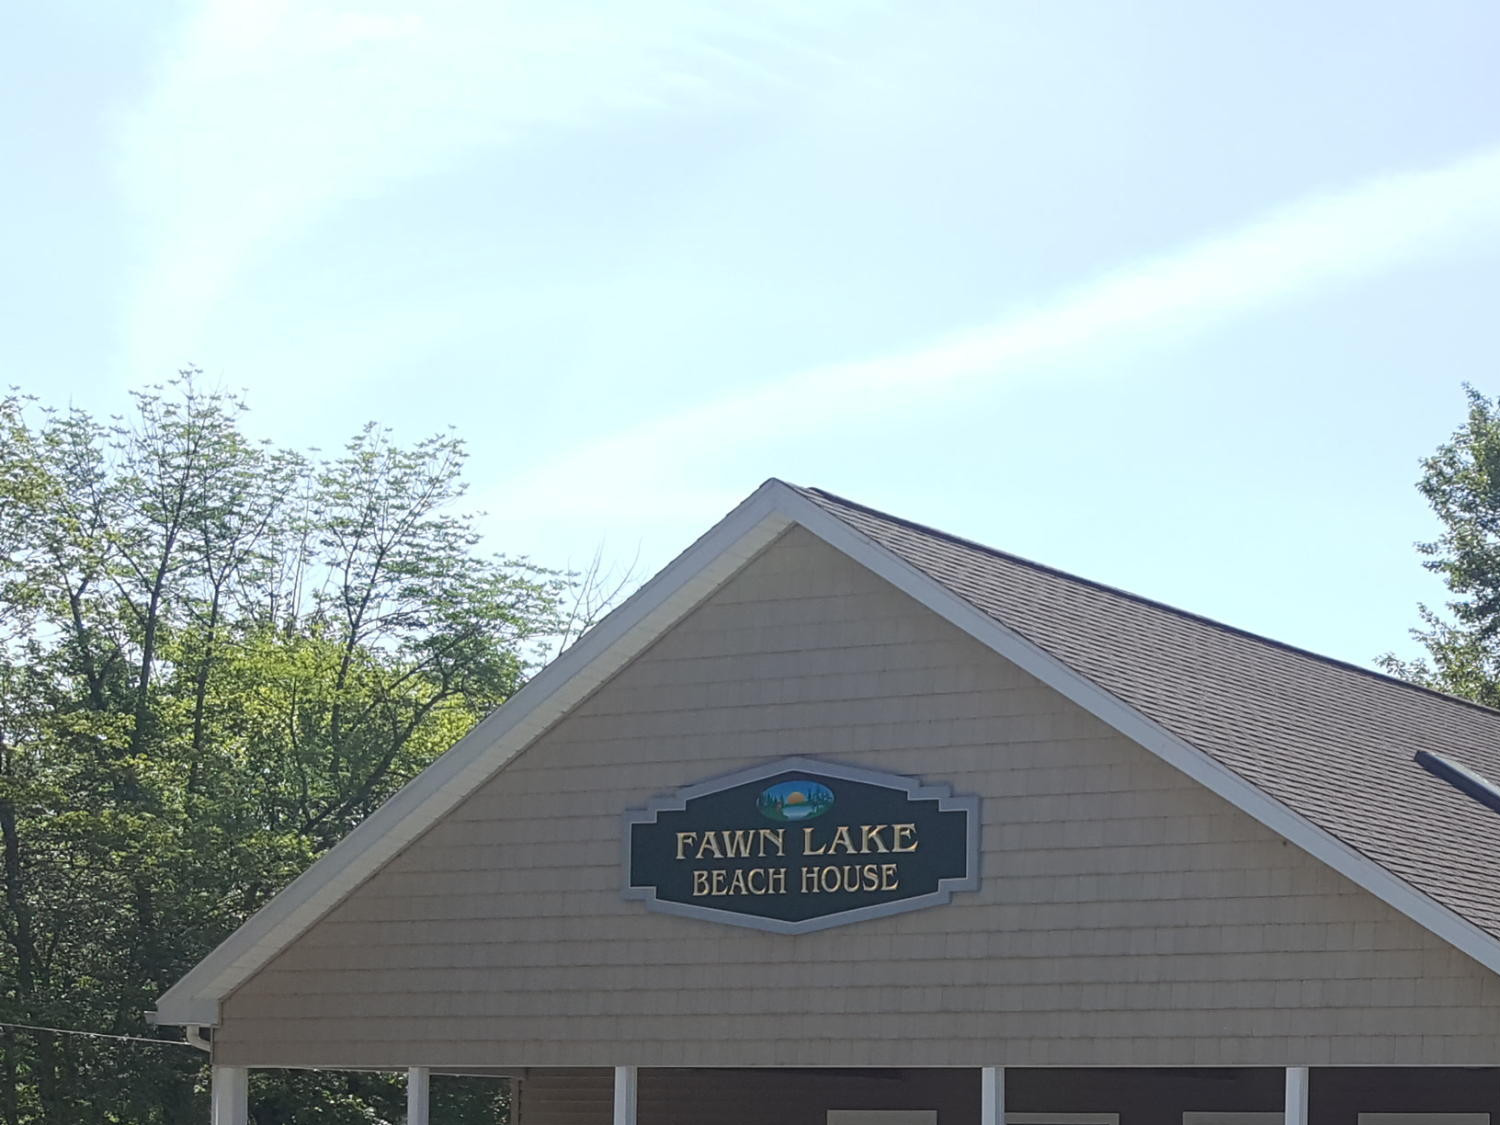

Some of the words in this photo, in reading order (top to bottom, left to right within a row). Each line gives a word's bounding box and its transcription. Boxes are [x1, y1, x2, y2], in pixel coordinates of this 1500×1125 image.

[675, 828, 786, 860] FAWN
[802, 823, 919, 857] LAKE
[692, 867, 787, 896] BEACH
[801, 863, 900, 893] HOUSE
